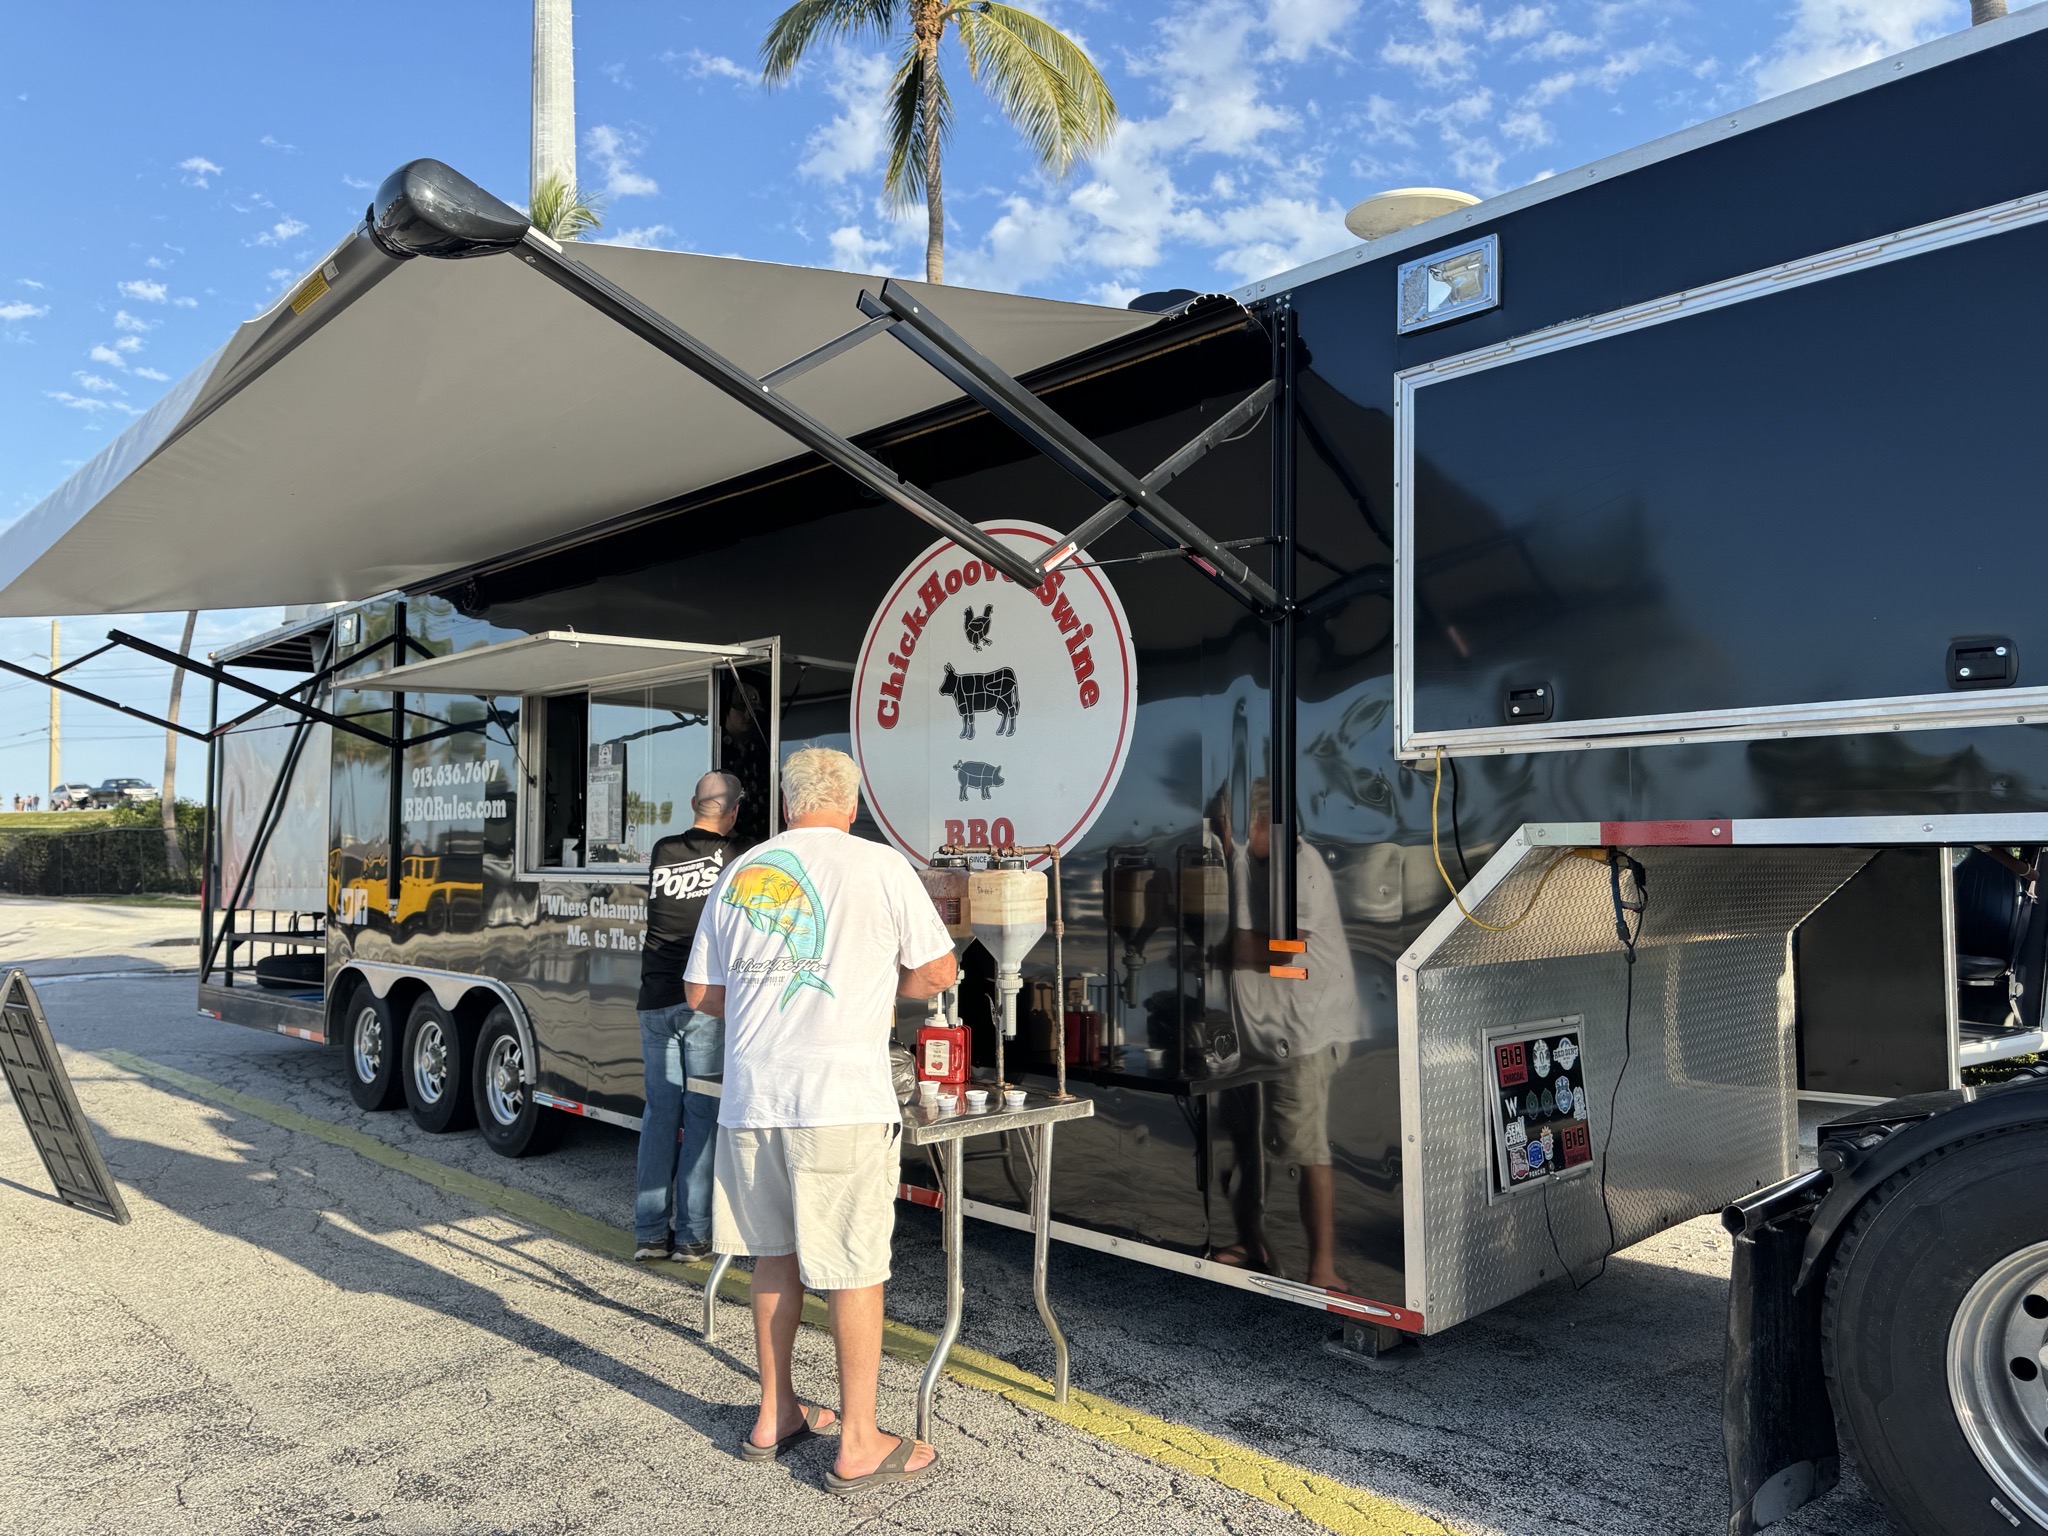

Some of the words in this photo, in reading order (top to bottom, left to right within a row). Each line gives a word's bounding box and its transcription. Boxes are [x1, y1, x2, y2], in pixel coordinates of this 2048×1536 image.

[412, 760, 499, 788] 913.636.7607
[404, 795, 507, 822] BBQRules.com
[944, 817, 1016, 849] BBQ
[970, 856, 987, 864] SINCE
[649, 866, 720, 899] Pop's
[609, 928, 636, 951] The
